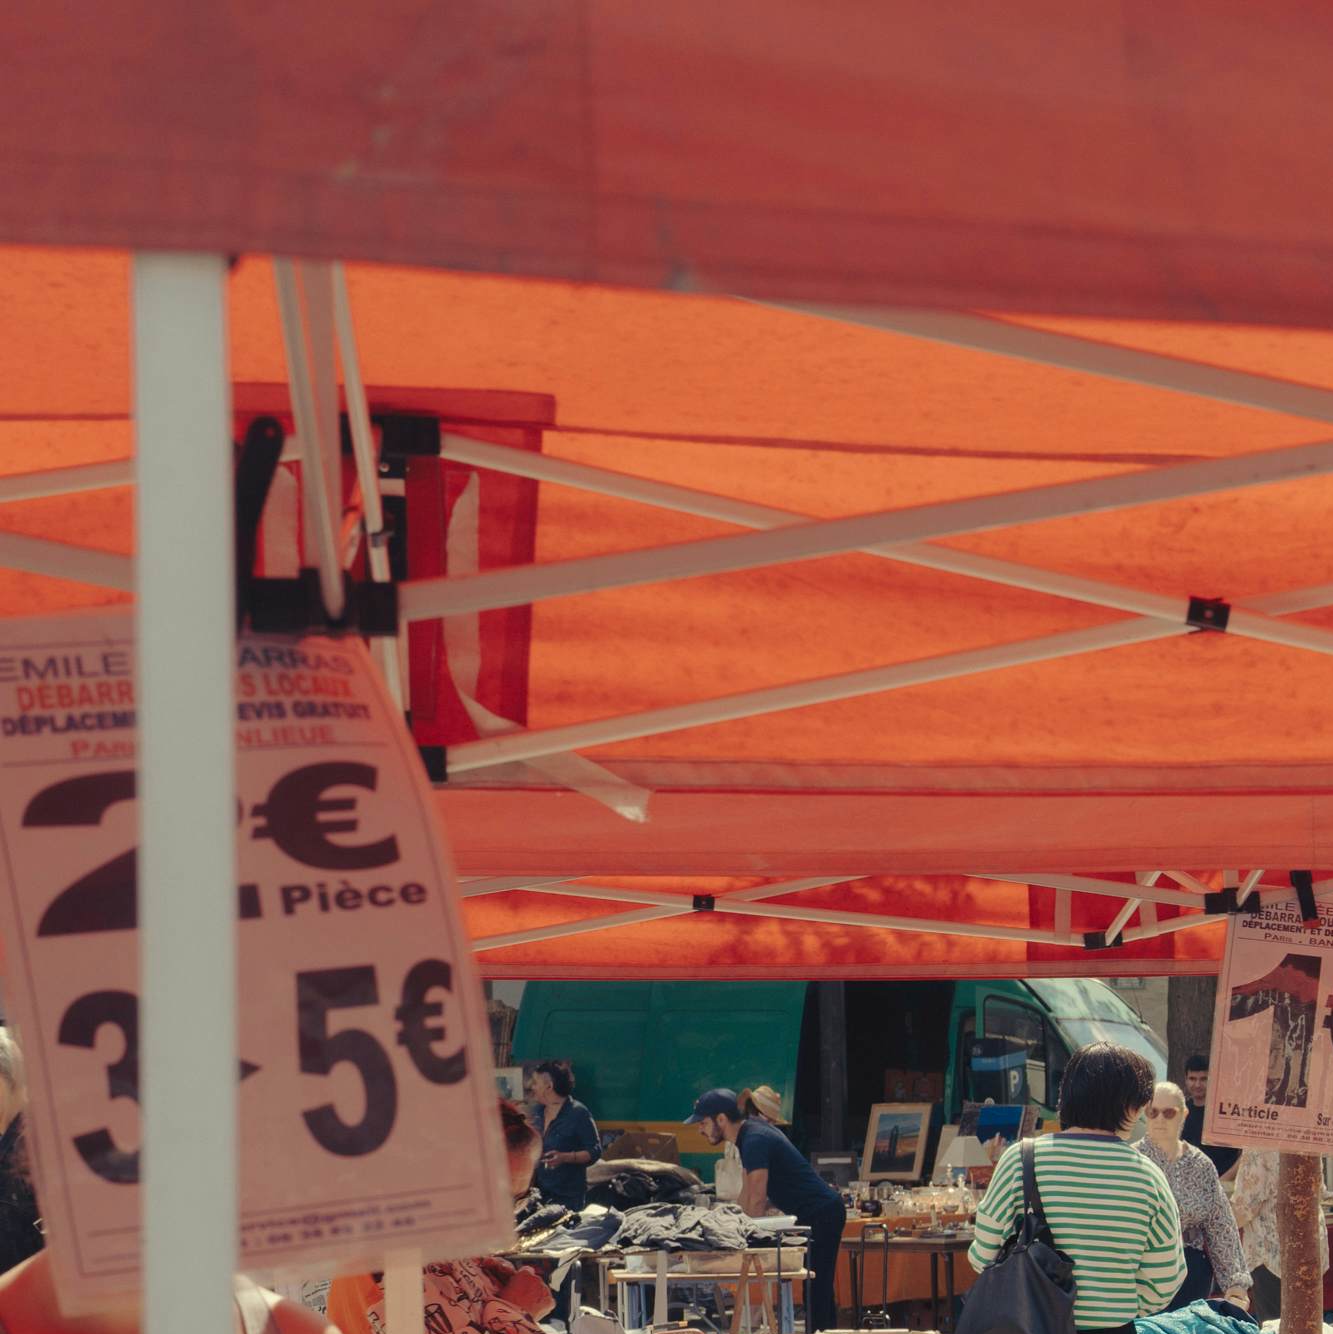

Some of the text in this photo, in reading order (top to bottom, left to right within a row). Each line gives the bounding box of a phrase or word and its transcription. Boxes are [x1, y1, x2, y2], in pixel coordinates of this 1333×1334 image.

[238, 702, 287, 720] EVIS
[292, 701, 370, 720] GRATUIT
[280, 877, 428, 915] Pièce
[1218, 1102, 1279, 1121] L'Article
[1317, 1113, 1330, 1126] Sur
